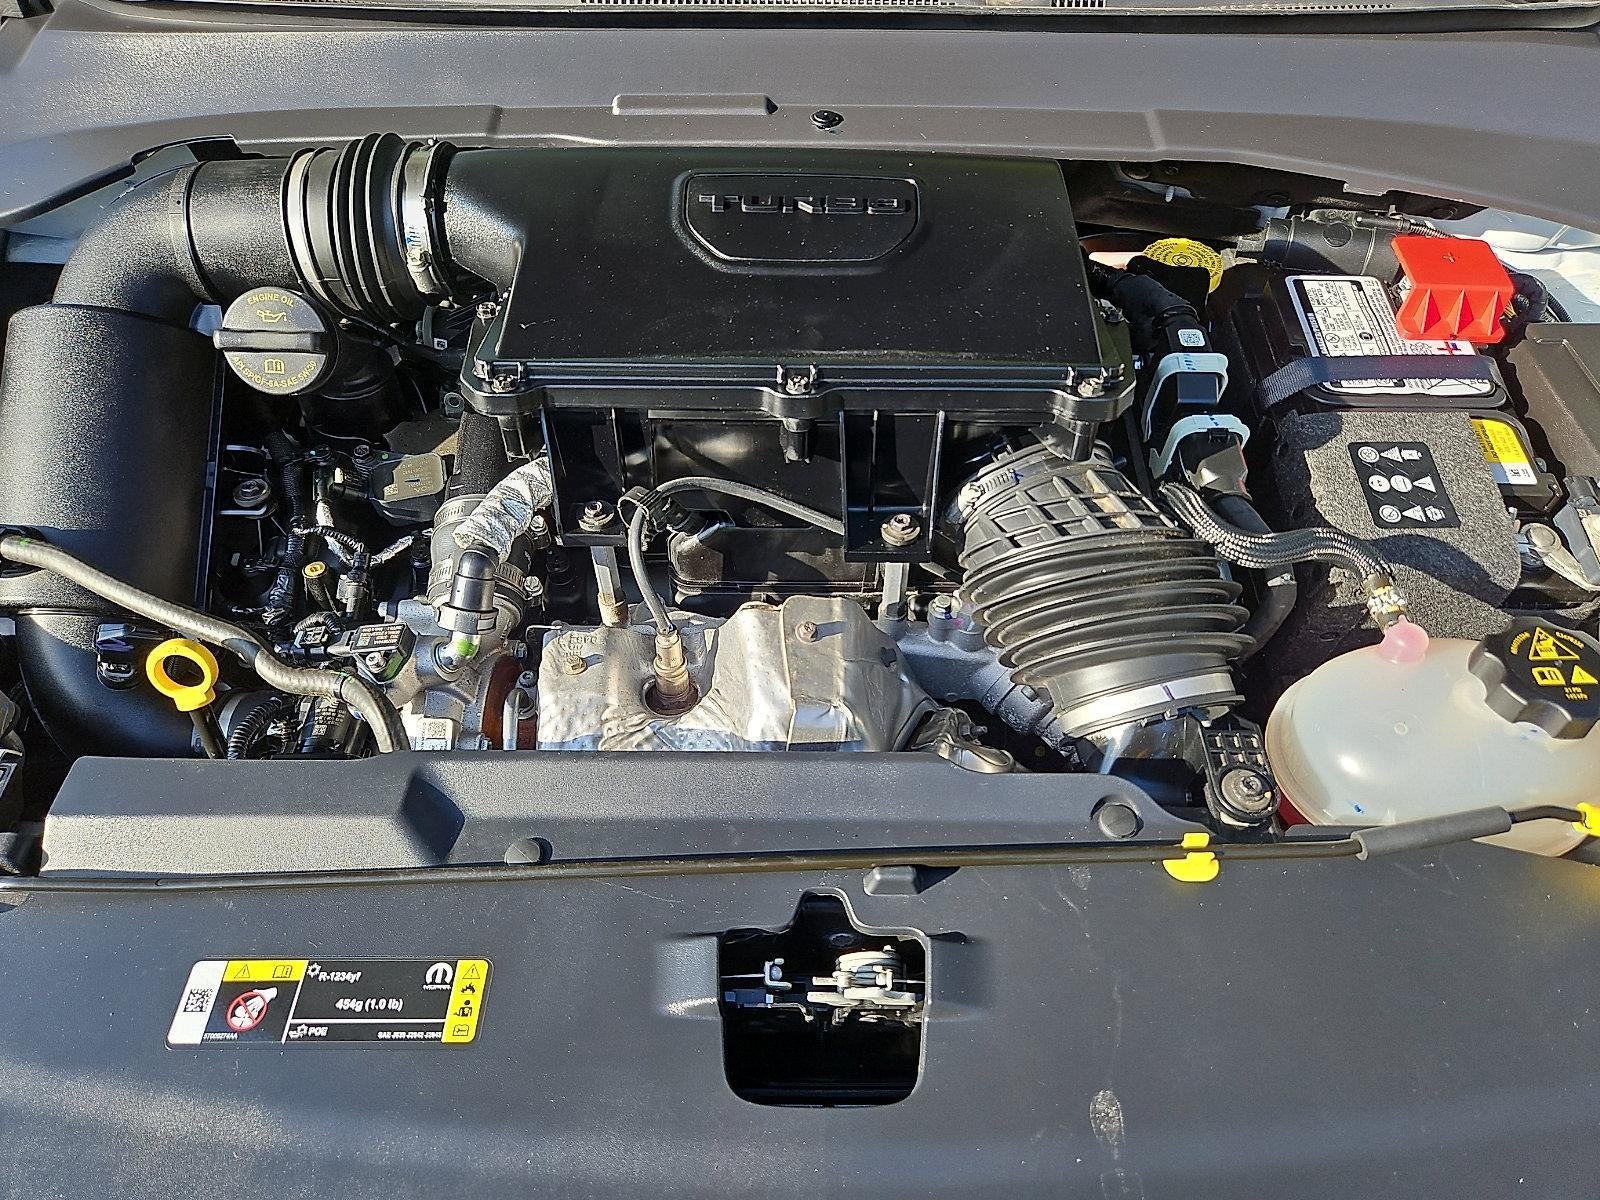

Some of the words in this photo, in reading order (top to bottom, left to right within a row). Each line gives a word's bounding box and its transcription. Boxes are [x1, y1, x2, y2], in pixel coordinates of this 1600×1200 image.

[698, 195, 907, 214] TURBO
[247, 293, 280, 306] ENGINE
[281, 296, 295, 308] OIL
[318, 971, 362, 983] R-1234yf
[335, 998, 364, 1012] 454g
[364, 998, 386, 1012] (1.0
[387, 998, 404, 1012] lb)
